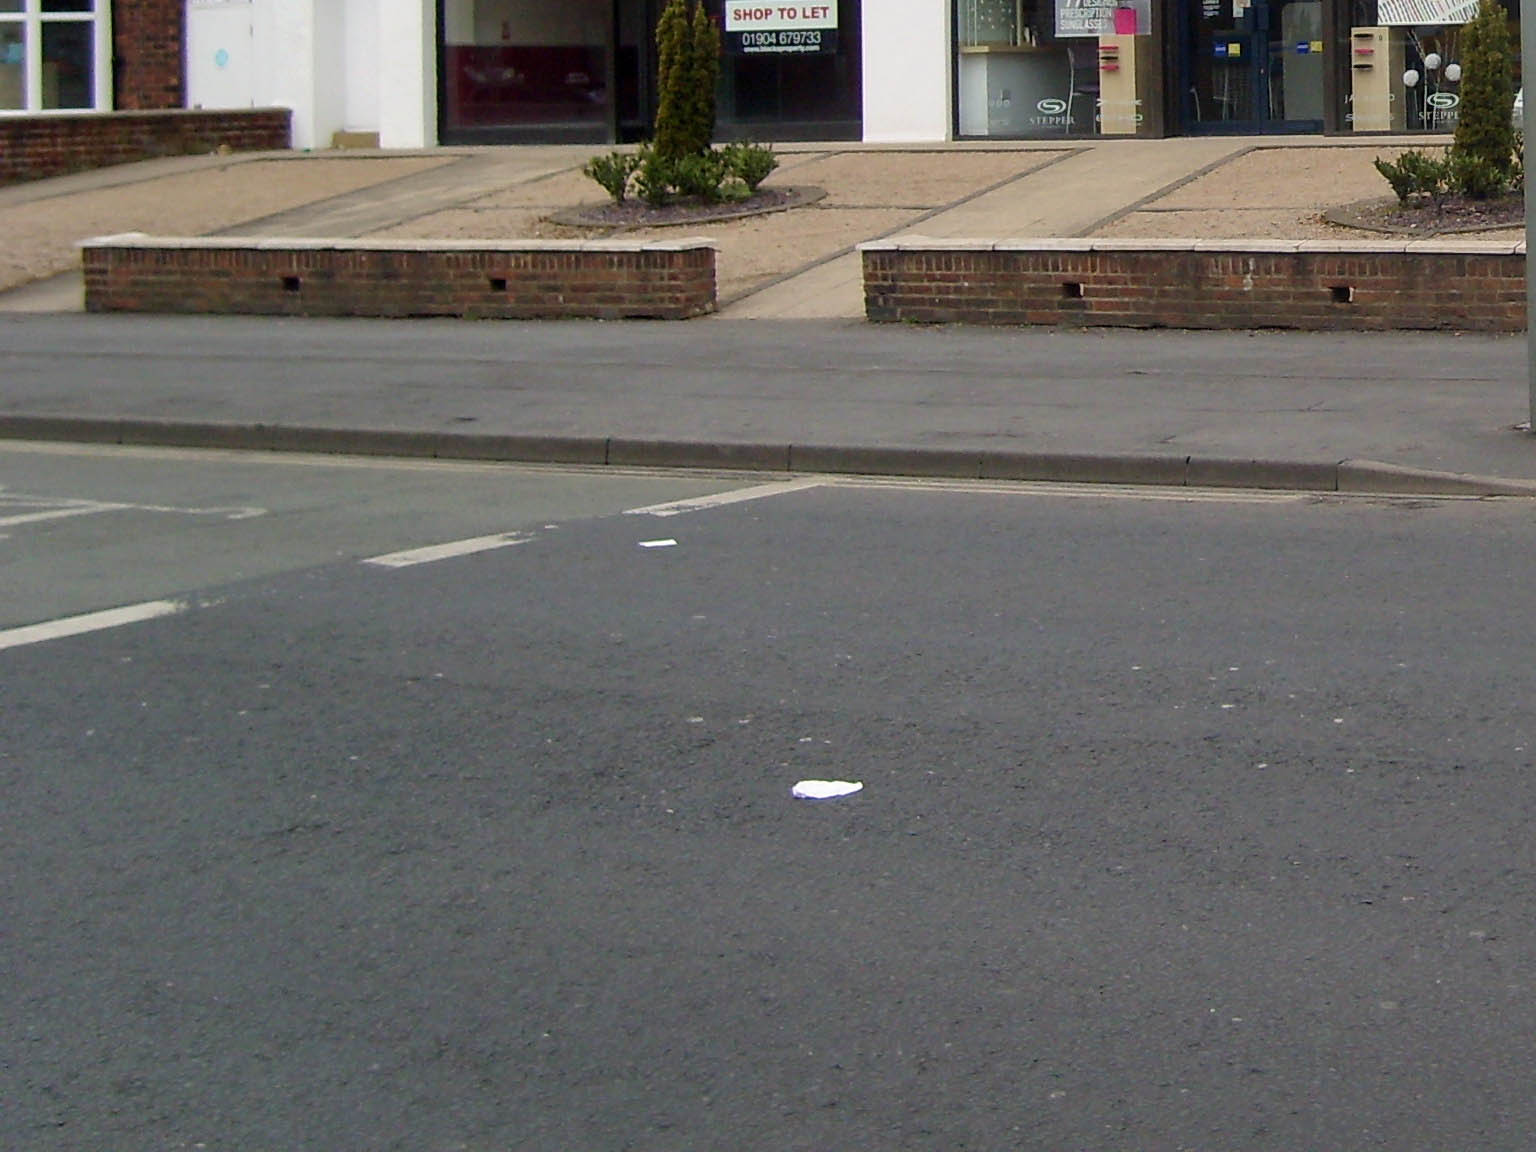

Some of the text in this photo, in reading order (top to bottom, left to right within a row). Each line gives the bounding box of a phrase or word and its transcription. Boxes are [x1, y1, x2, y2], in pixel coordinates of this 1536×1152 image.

[733, 7, 830, 21] SHOP TO LET
[742, 31, 821, 45] 01904 679733
